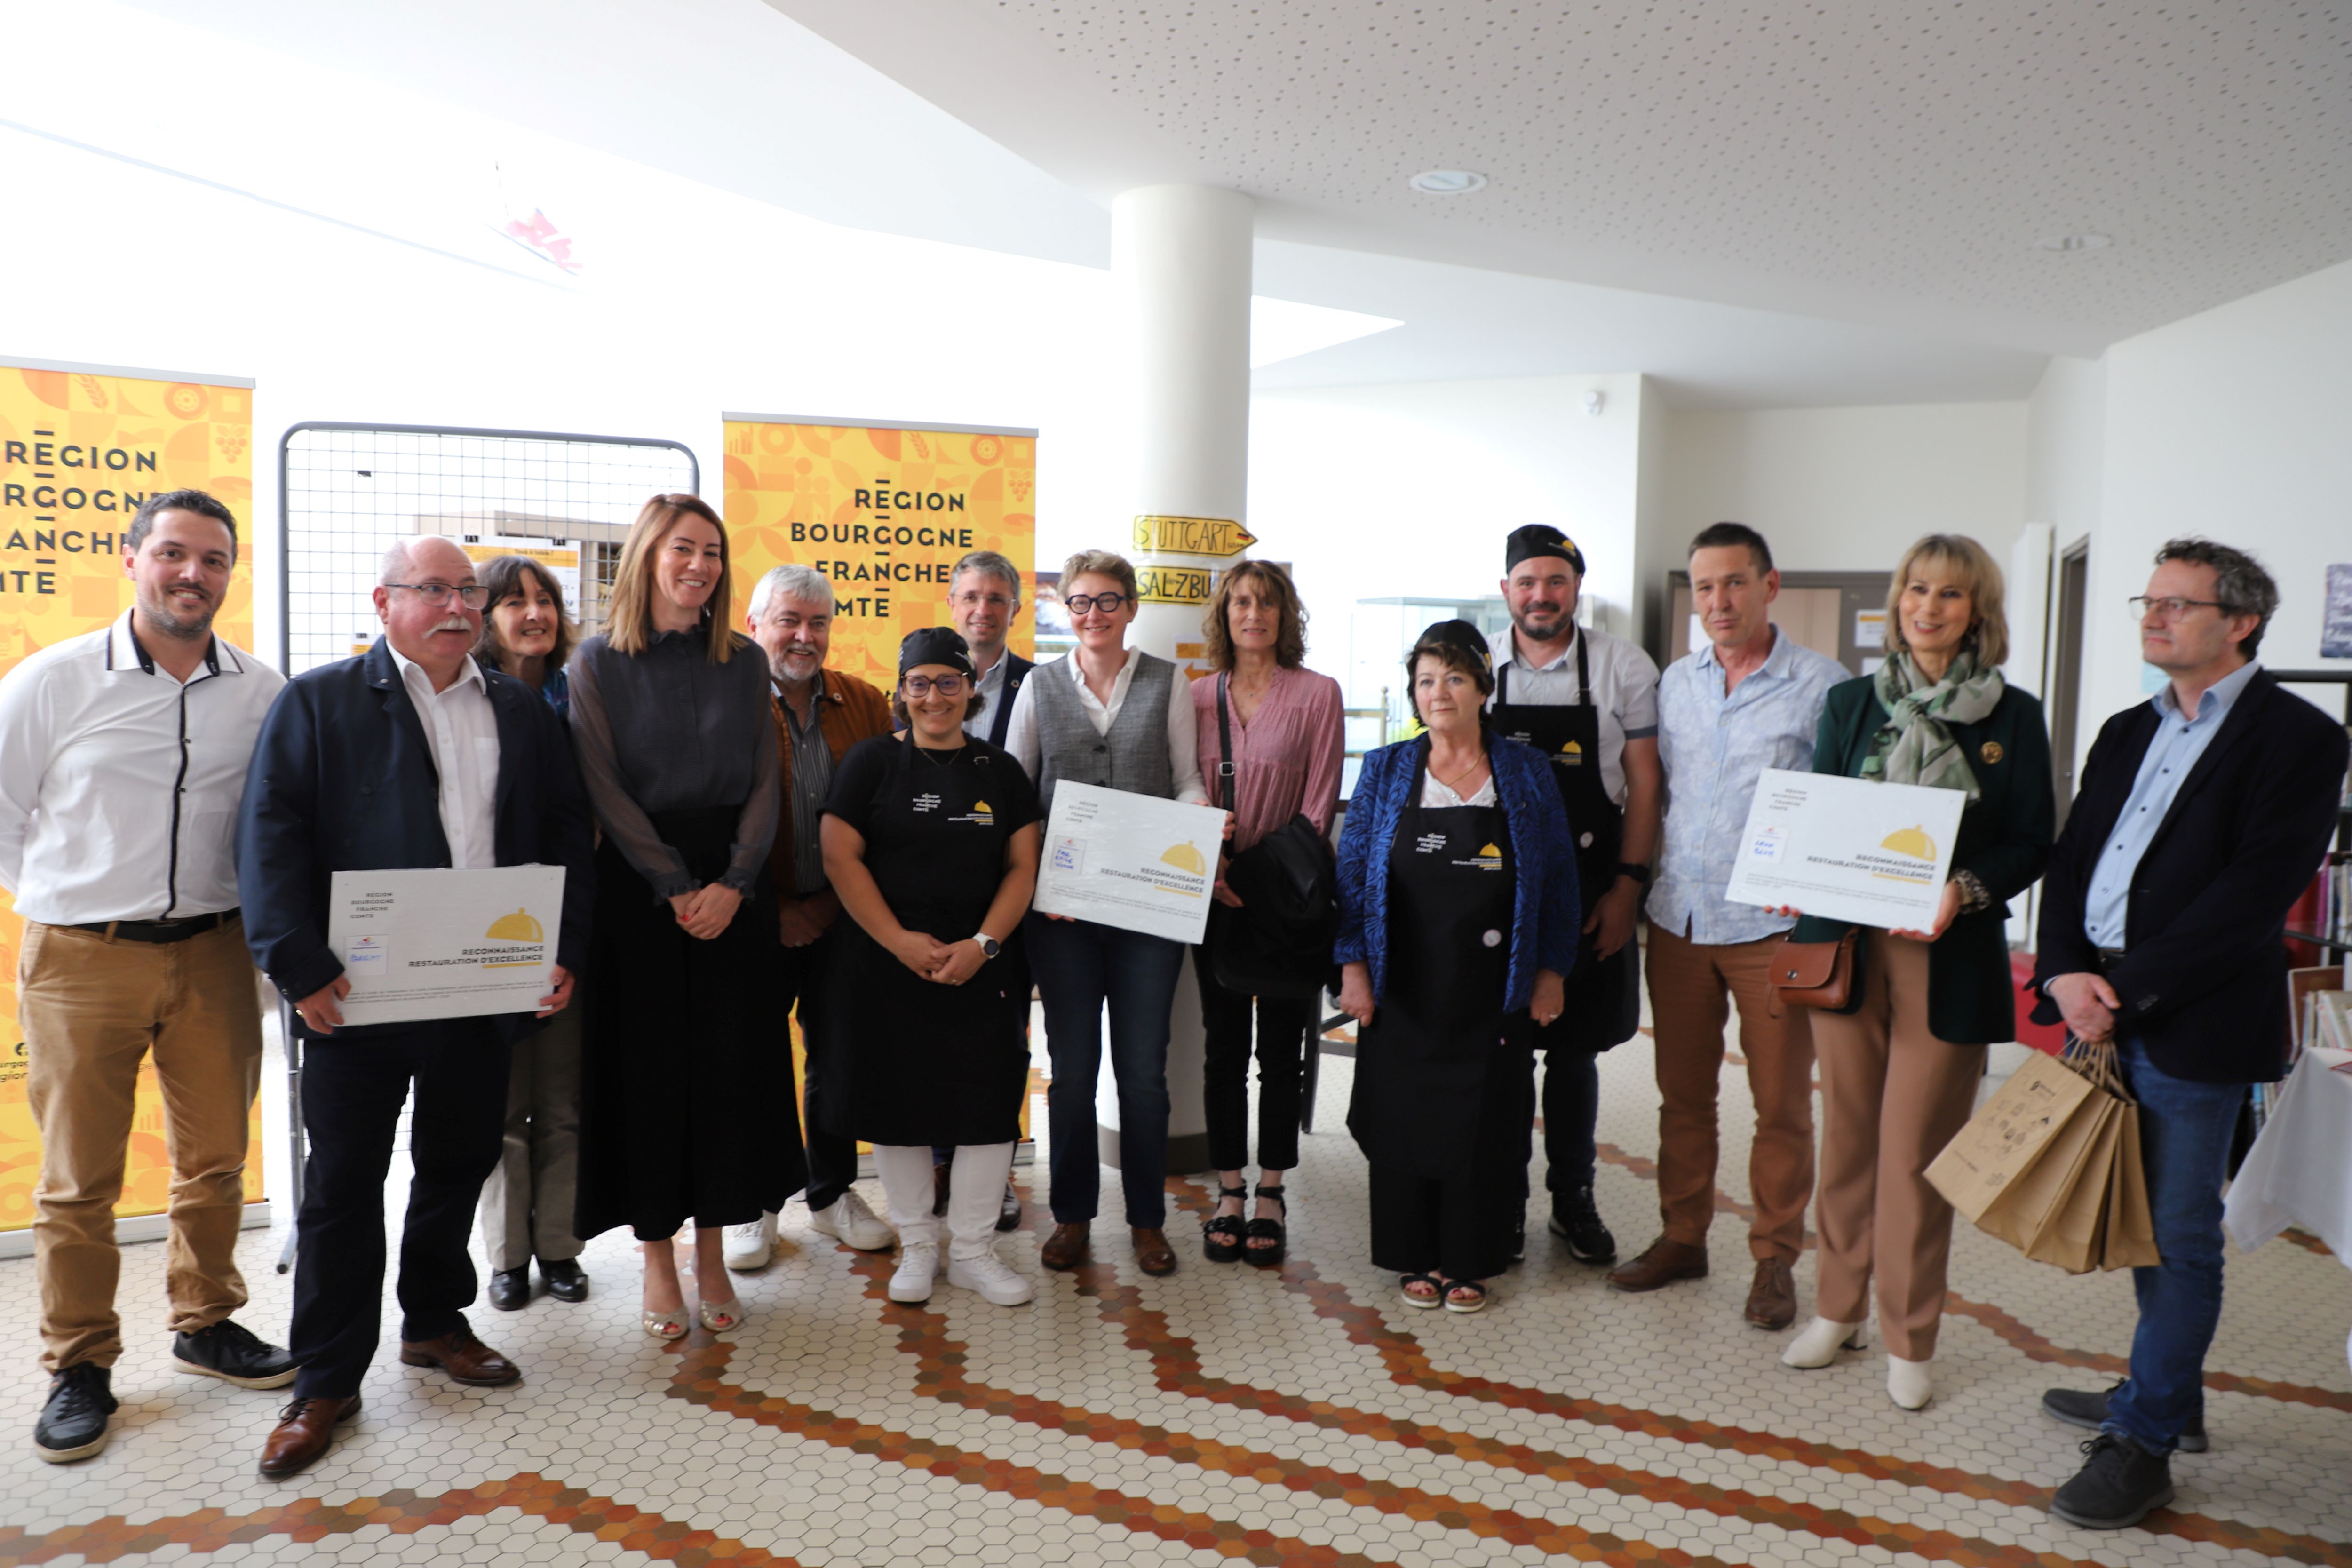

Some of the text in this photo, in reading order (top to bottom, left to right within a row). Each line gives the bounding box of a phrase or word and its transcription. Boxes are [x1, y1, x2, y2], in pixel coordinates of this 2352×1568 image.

[4, 483, 162, 513] RGOGN
[0, 528, 127, 555] ANCH
[791, 522, 973, 548] BOURGOGNE
[1138, 519, 1231, 552] STUTTGART
[816, 561, 950, 583] FRANCHE
[1138, 572, 1215, 599] SALZBU
[1807, 855, 1869, 870] RESTAURATION
[1856, 854, 1936, 870] RECONNAISSANCE
[1100, 868, 1203, 893] RESTAURATION D'EXCELLENCE
[1140, 868, 1205, 885] RECONNAISSANCE
[409, 954, 543, 967] RESTAURATION D'EXCELLENCE
[462, 946, 544, 955] RECONNAISSANCE
